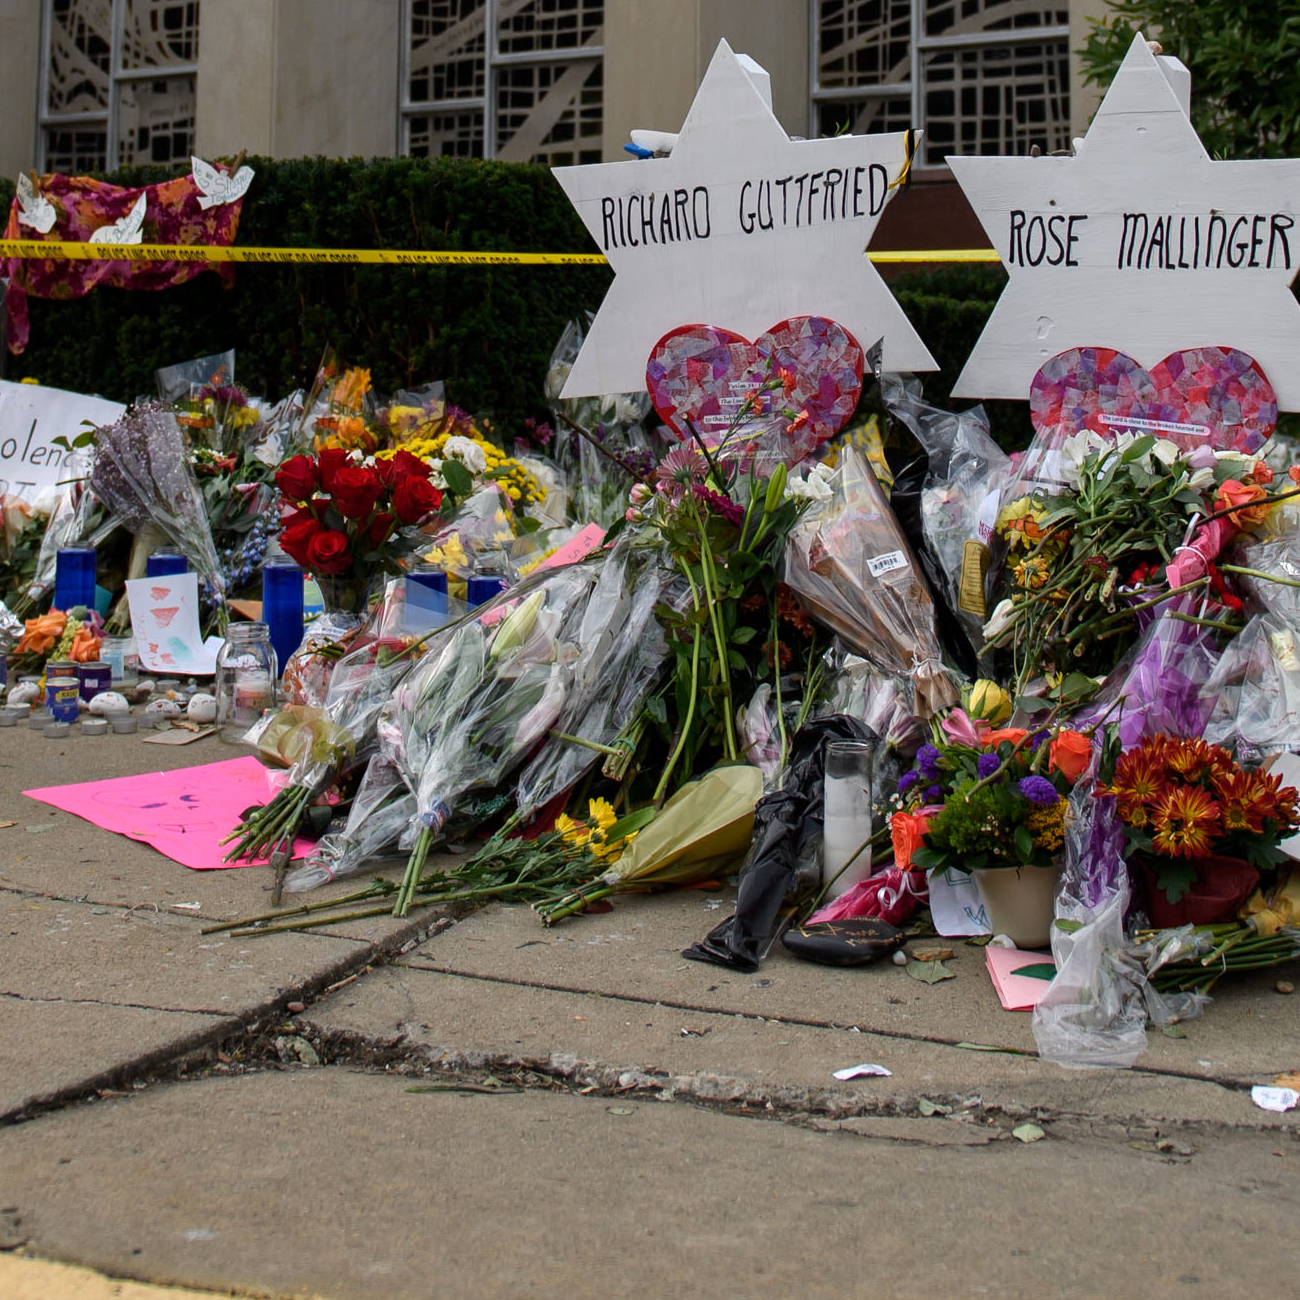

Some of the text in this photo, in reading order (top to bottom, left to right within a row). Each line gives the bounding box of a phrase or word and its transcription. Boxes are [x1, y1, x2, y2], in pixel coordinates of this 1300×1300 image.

[601, 185, 712, 251] RICHARD
[1009, 210, 1294, 270] ROSE MALLINGER
